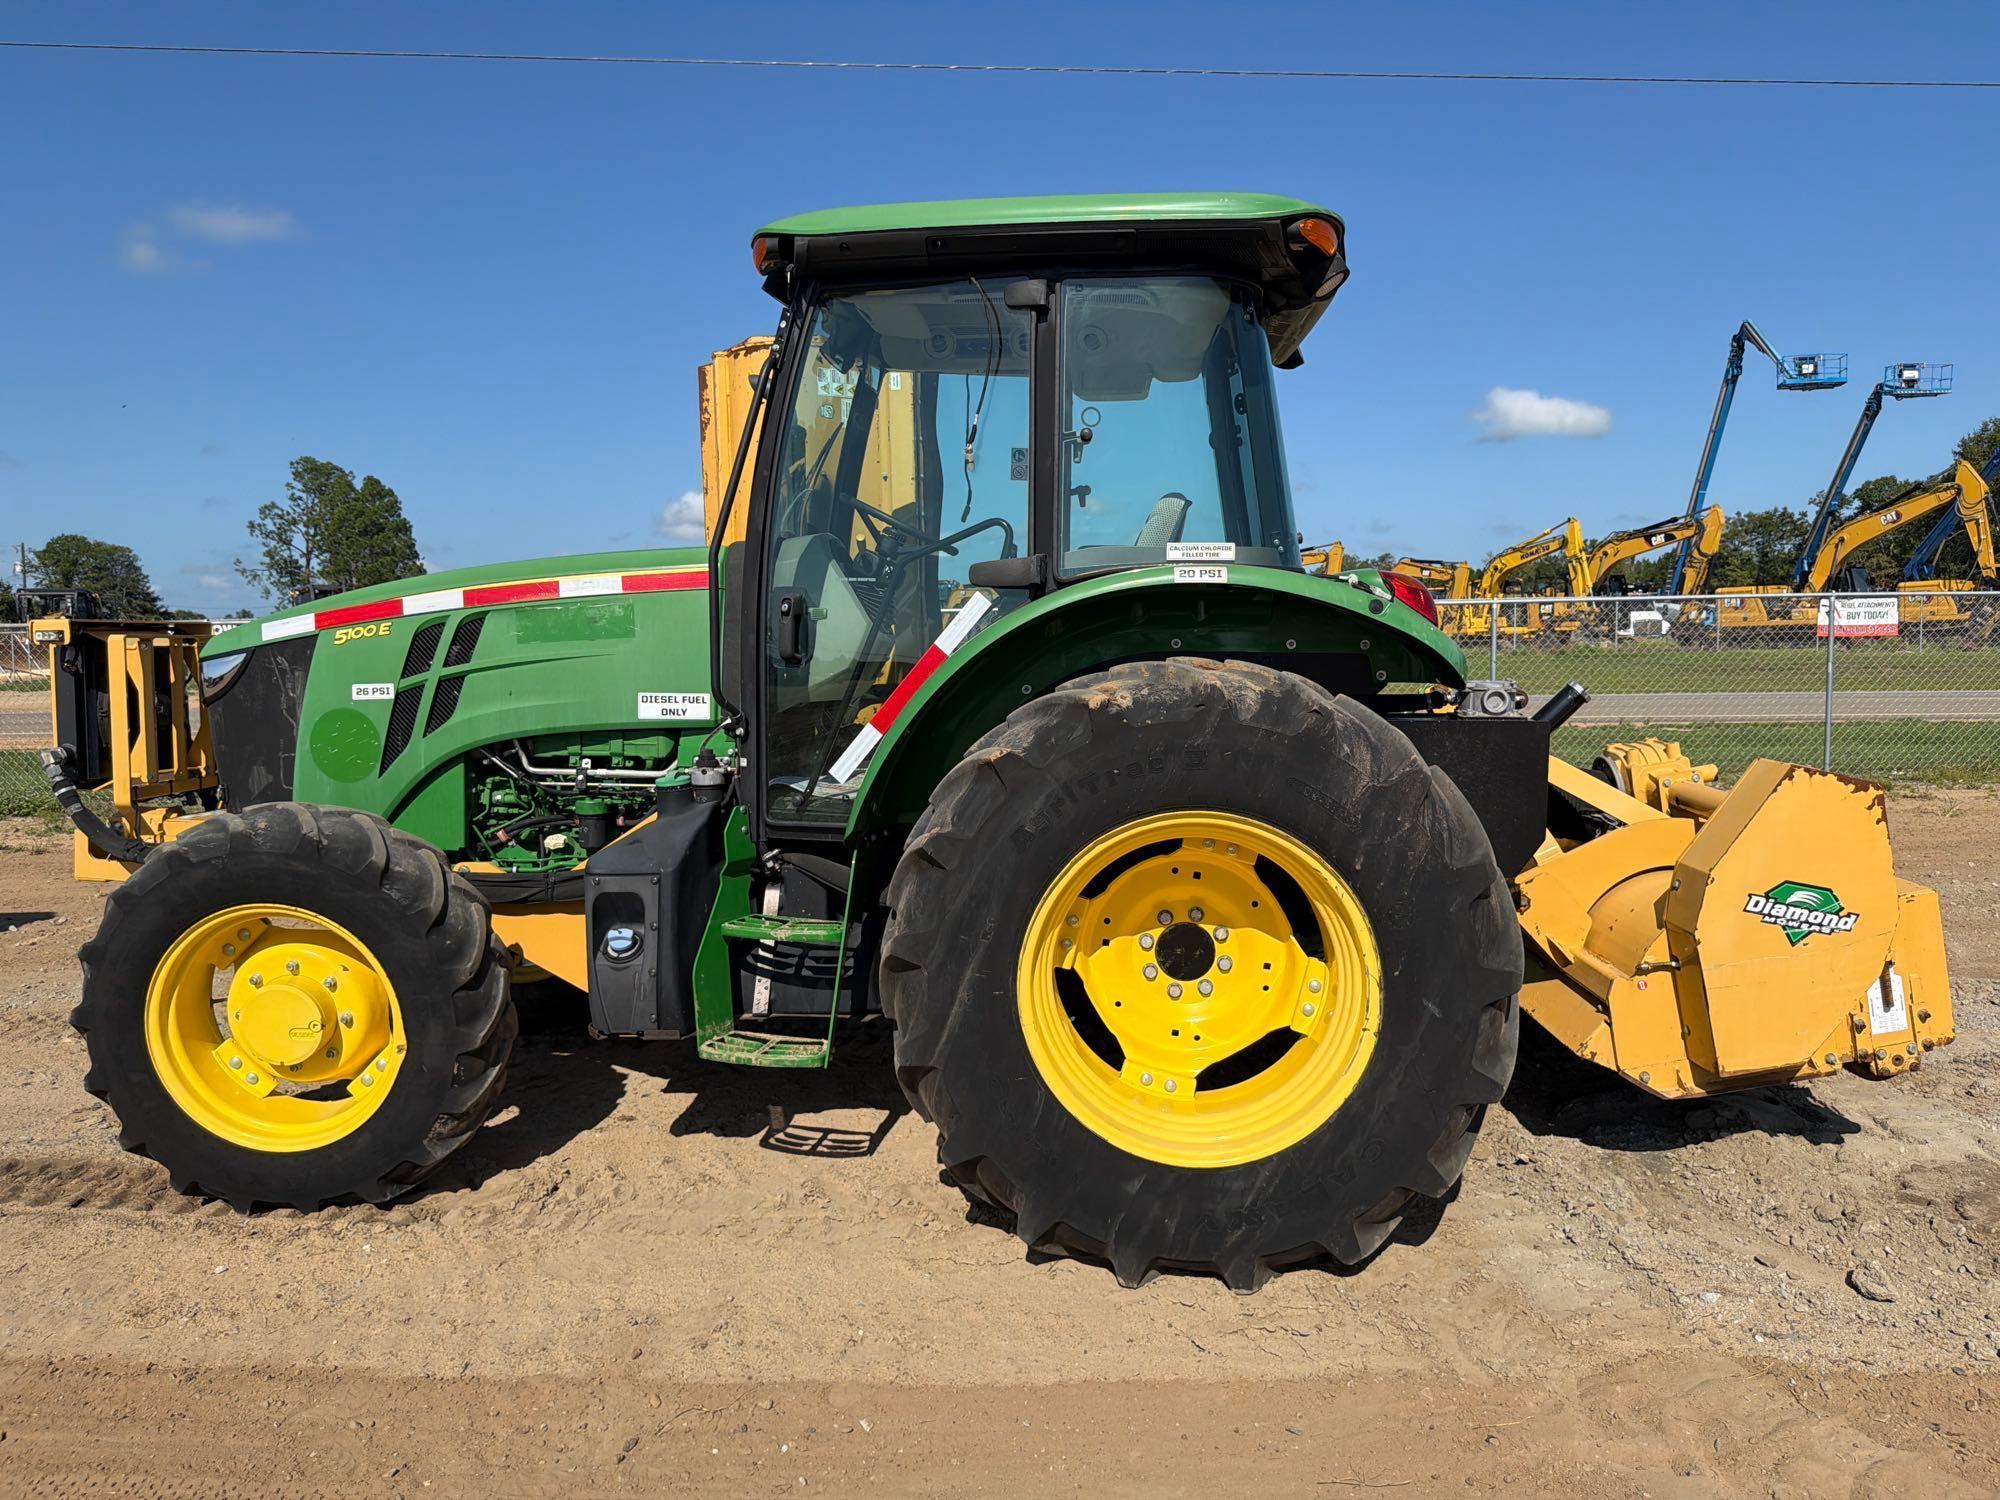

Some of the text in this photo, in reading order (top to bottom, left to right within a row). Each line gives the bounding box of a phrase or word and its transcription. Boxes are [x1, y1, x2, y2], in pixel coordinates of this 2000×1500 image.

[1880, 511, 1898, 526] CAT
[1651, 533, 1666, 547] CAT
[1179, 569, 1222, 578] 20 PSI
[1846, 611, 1889, 620] BUY TODAY!
[334, 622, 392, 645] 5100 E
[356, 686, 390, 696] 26 PSI
[641, 695, 707, 704] DIESEL FUEL
[661, 708, 687, 716] ONLY
[1745, 895, 1858, 930] Diamond
[1763, 916, 1832, 934] MOWERS
